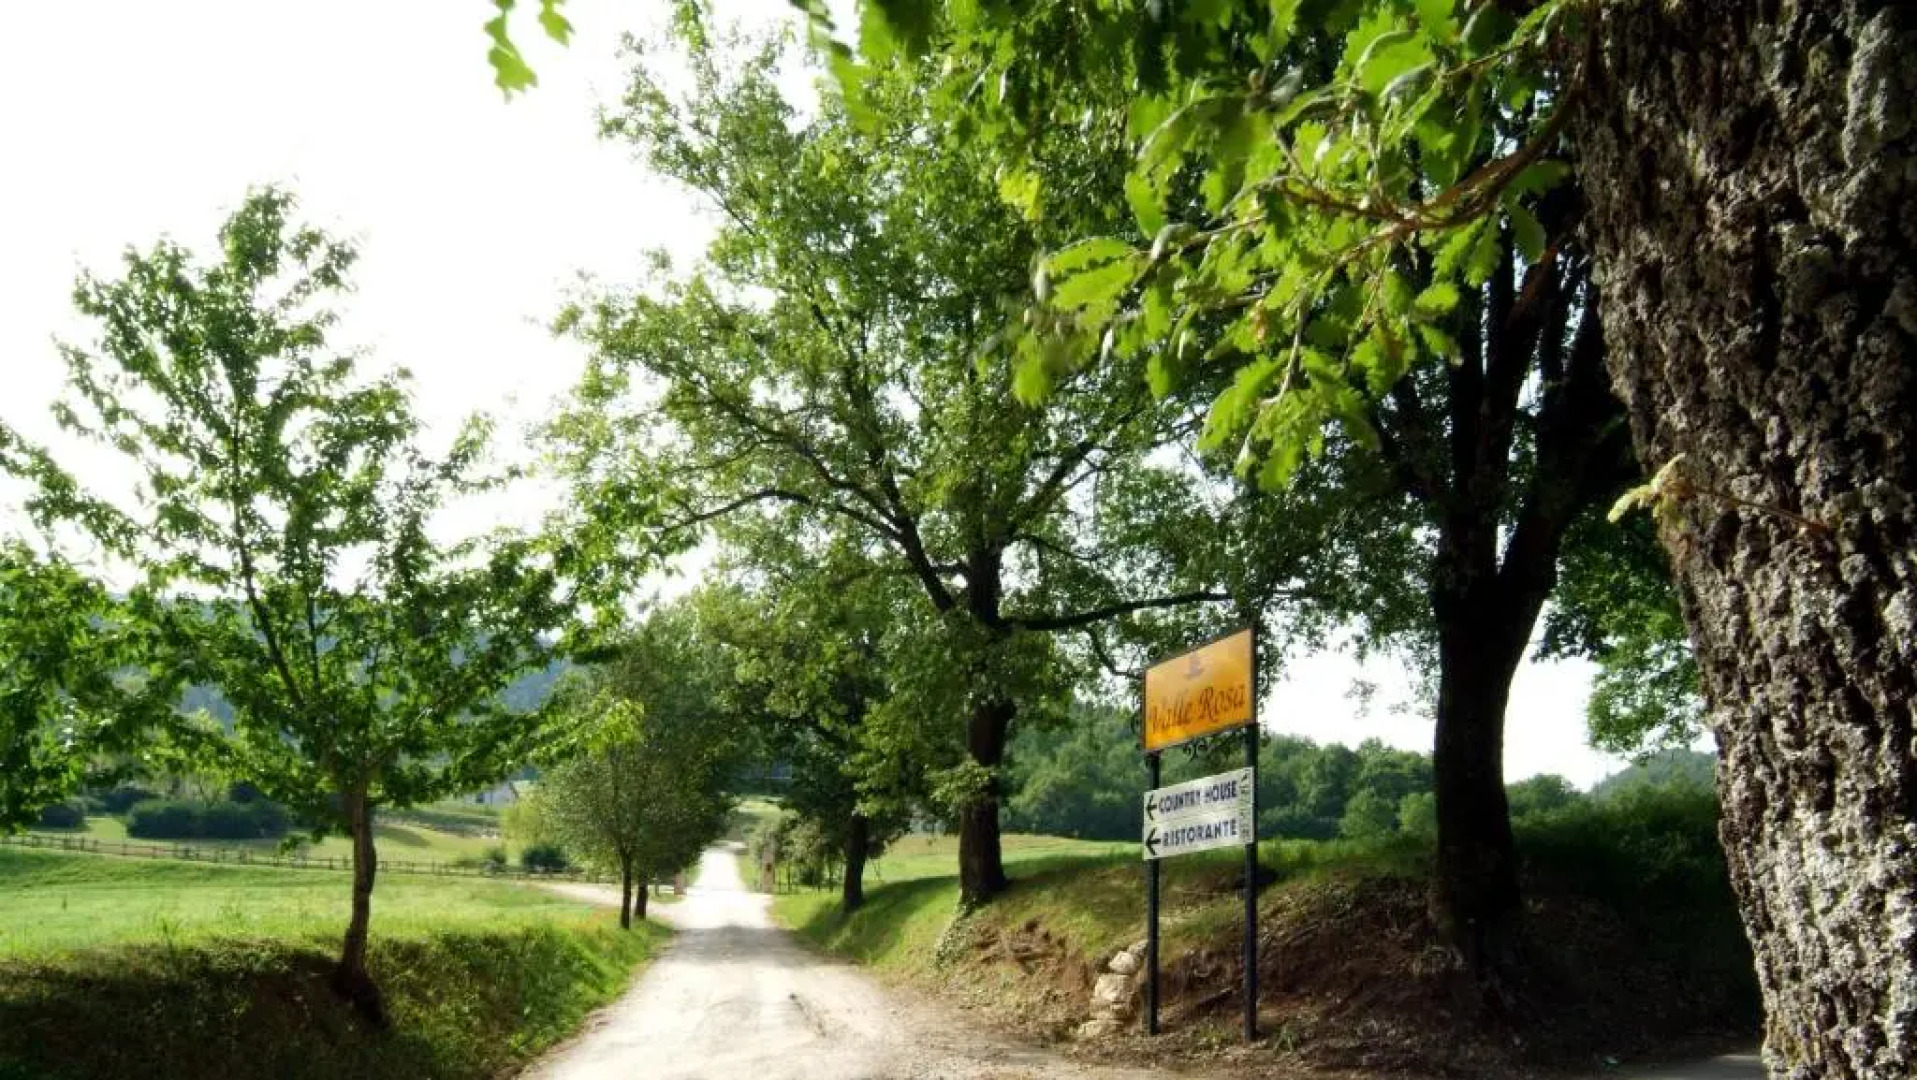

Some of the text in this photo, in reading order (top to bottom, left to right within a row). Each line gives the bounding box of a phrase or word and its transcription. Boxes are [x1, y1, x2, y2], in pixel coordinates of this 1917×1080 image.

[1198, 684, 1246, 723] Rosa
[1159, 780, 1238, 815] COUNTRY HOUSE
[1163, 818, 1238, 847] RISTORANTE
